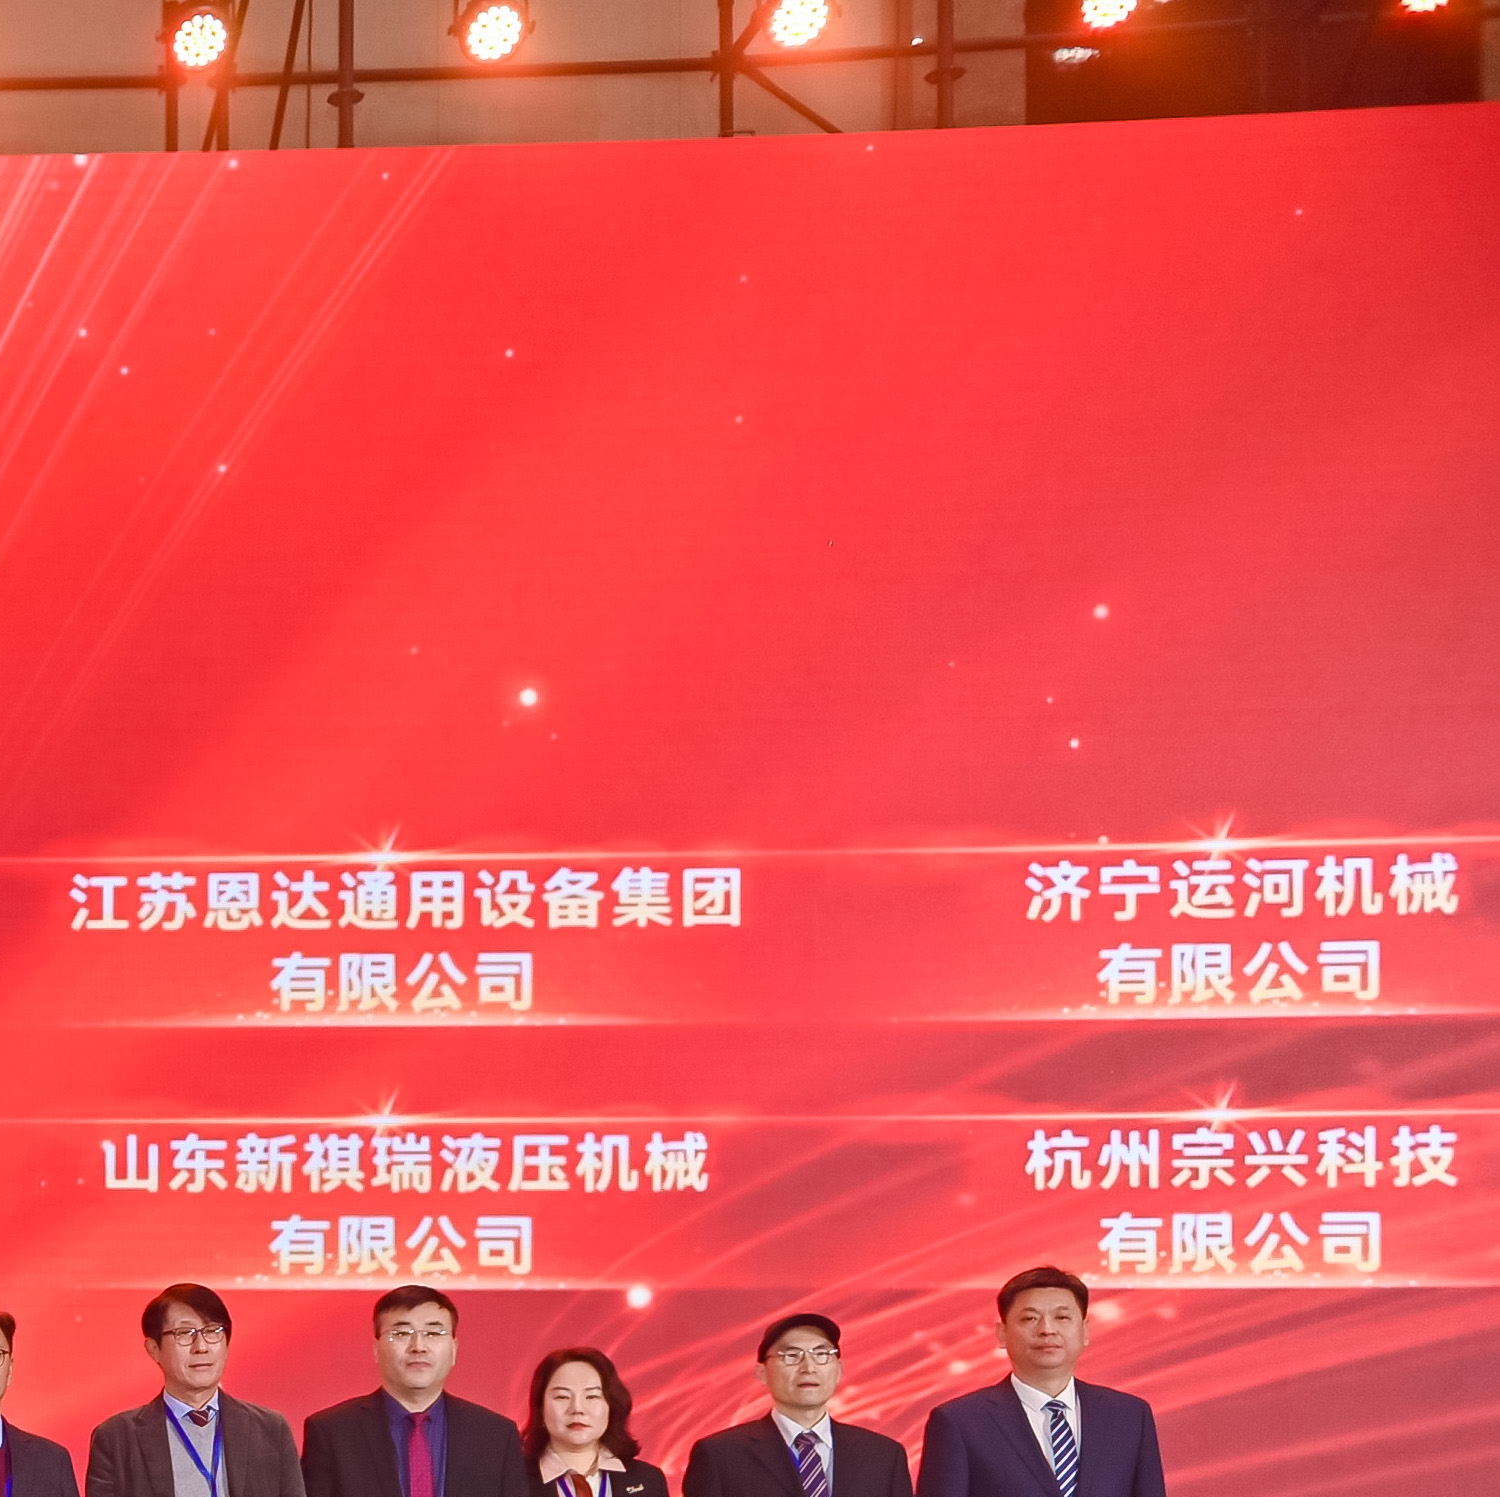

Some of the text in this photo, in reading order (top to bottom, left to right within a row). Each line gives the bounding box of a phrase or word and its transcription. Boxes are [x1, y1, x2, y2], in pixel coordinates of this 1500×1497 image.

[69, 866, 742, 931] 江苏恩达通用设备集团
[1024, 854, 1460, 922] 济宁运河机械
[270, 951, 534, 1012] 有限公司
[1096, 940, 1380, 1004] 有限公司
[102, 1131, 709, 1192] 山东新祺瑞液压机械
[1025, 1125, 1459, 1190] 杭州宗兴科技
[270, 1215, 534, 1276] 有限公司
[1099, 1211, 1381, 1274] 有限公司
